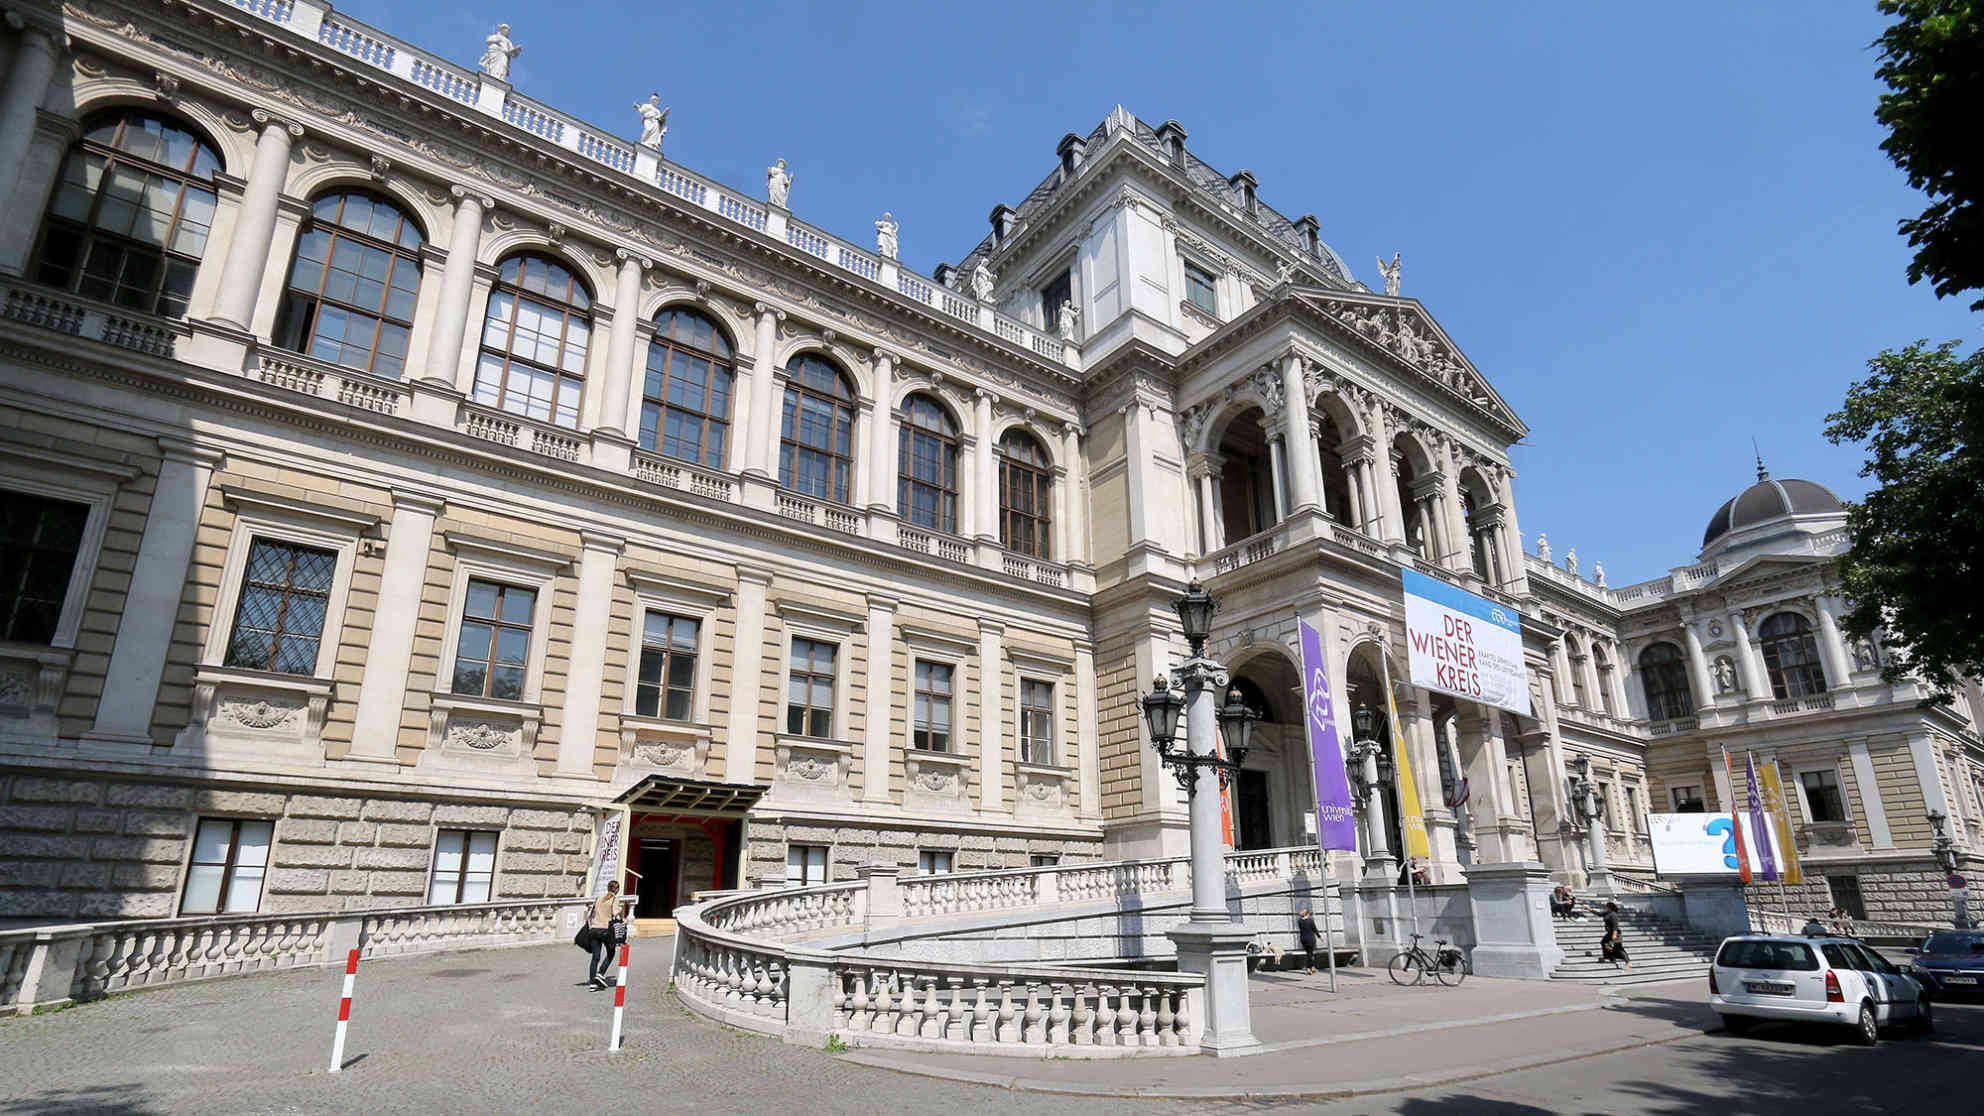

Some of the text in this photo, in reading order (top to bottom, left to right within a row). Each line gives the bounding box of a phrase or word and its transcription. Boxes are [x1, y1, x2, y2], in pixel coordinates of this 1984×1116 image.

[1443, 614, 1474, 645] DER
[1409, 627, 1478, 671] WIENER
[1436, 662, 1481, 697] KREIS
[605, 821, 621, 834] DER
